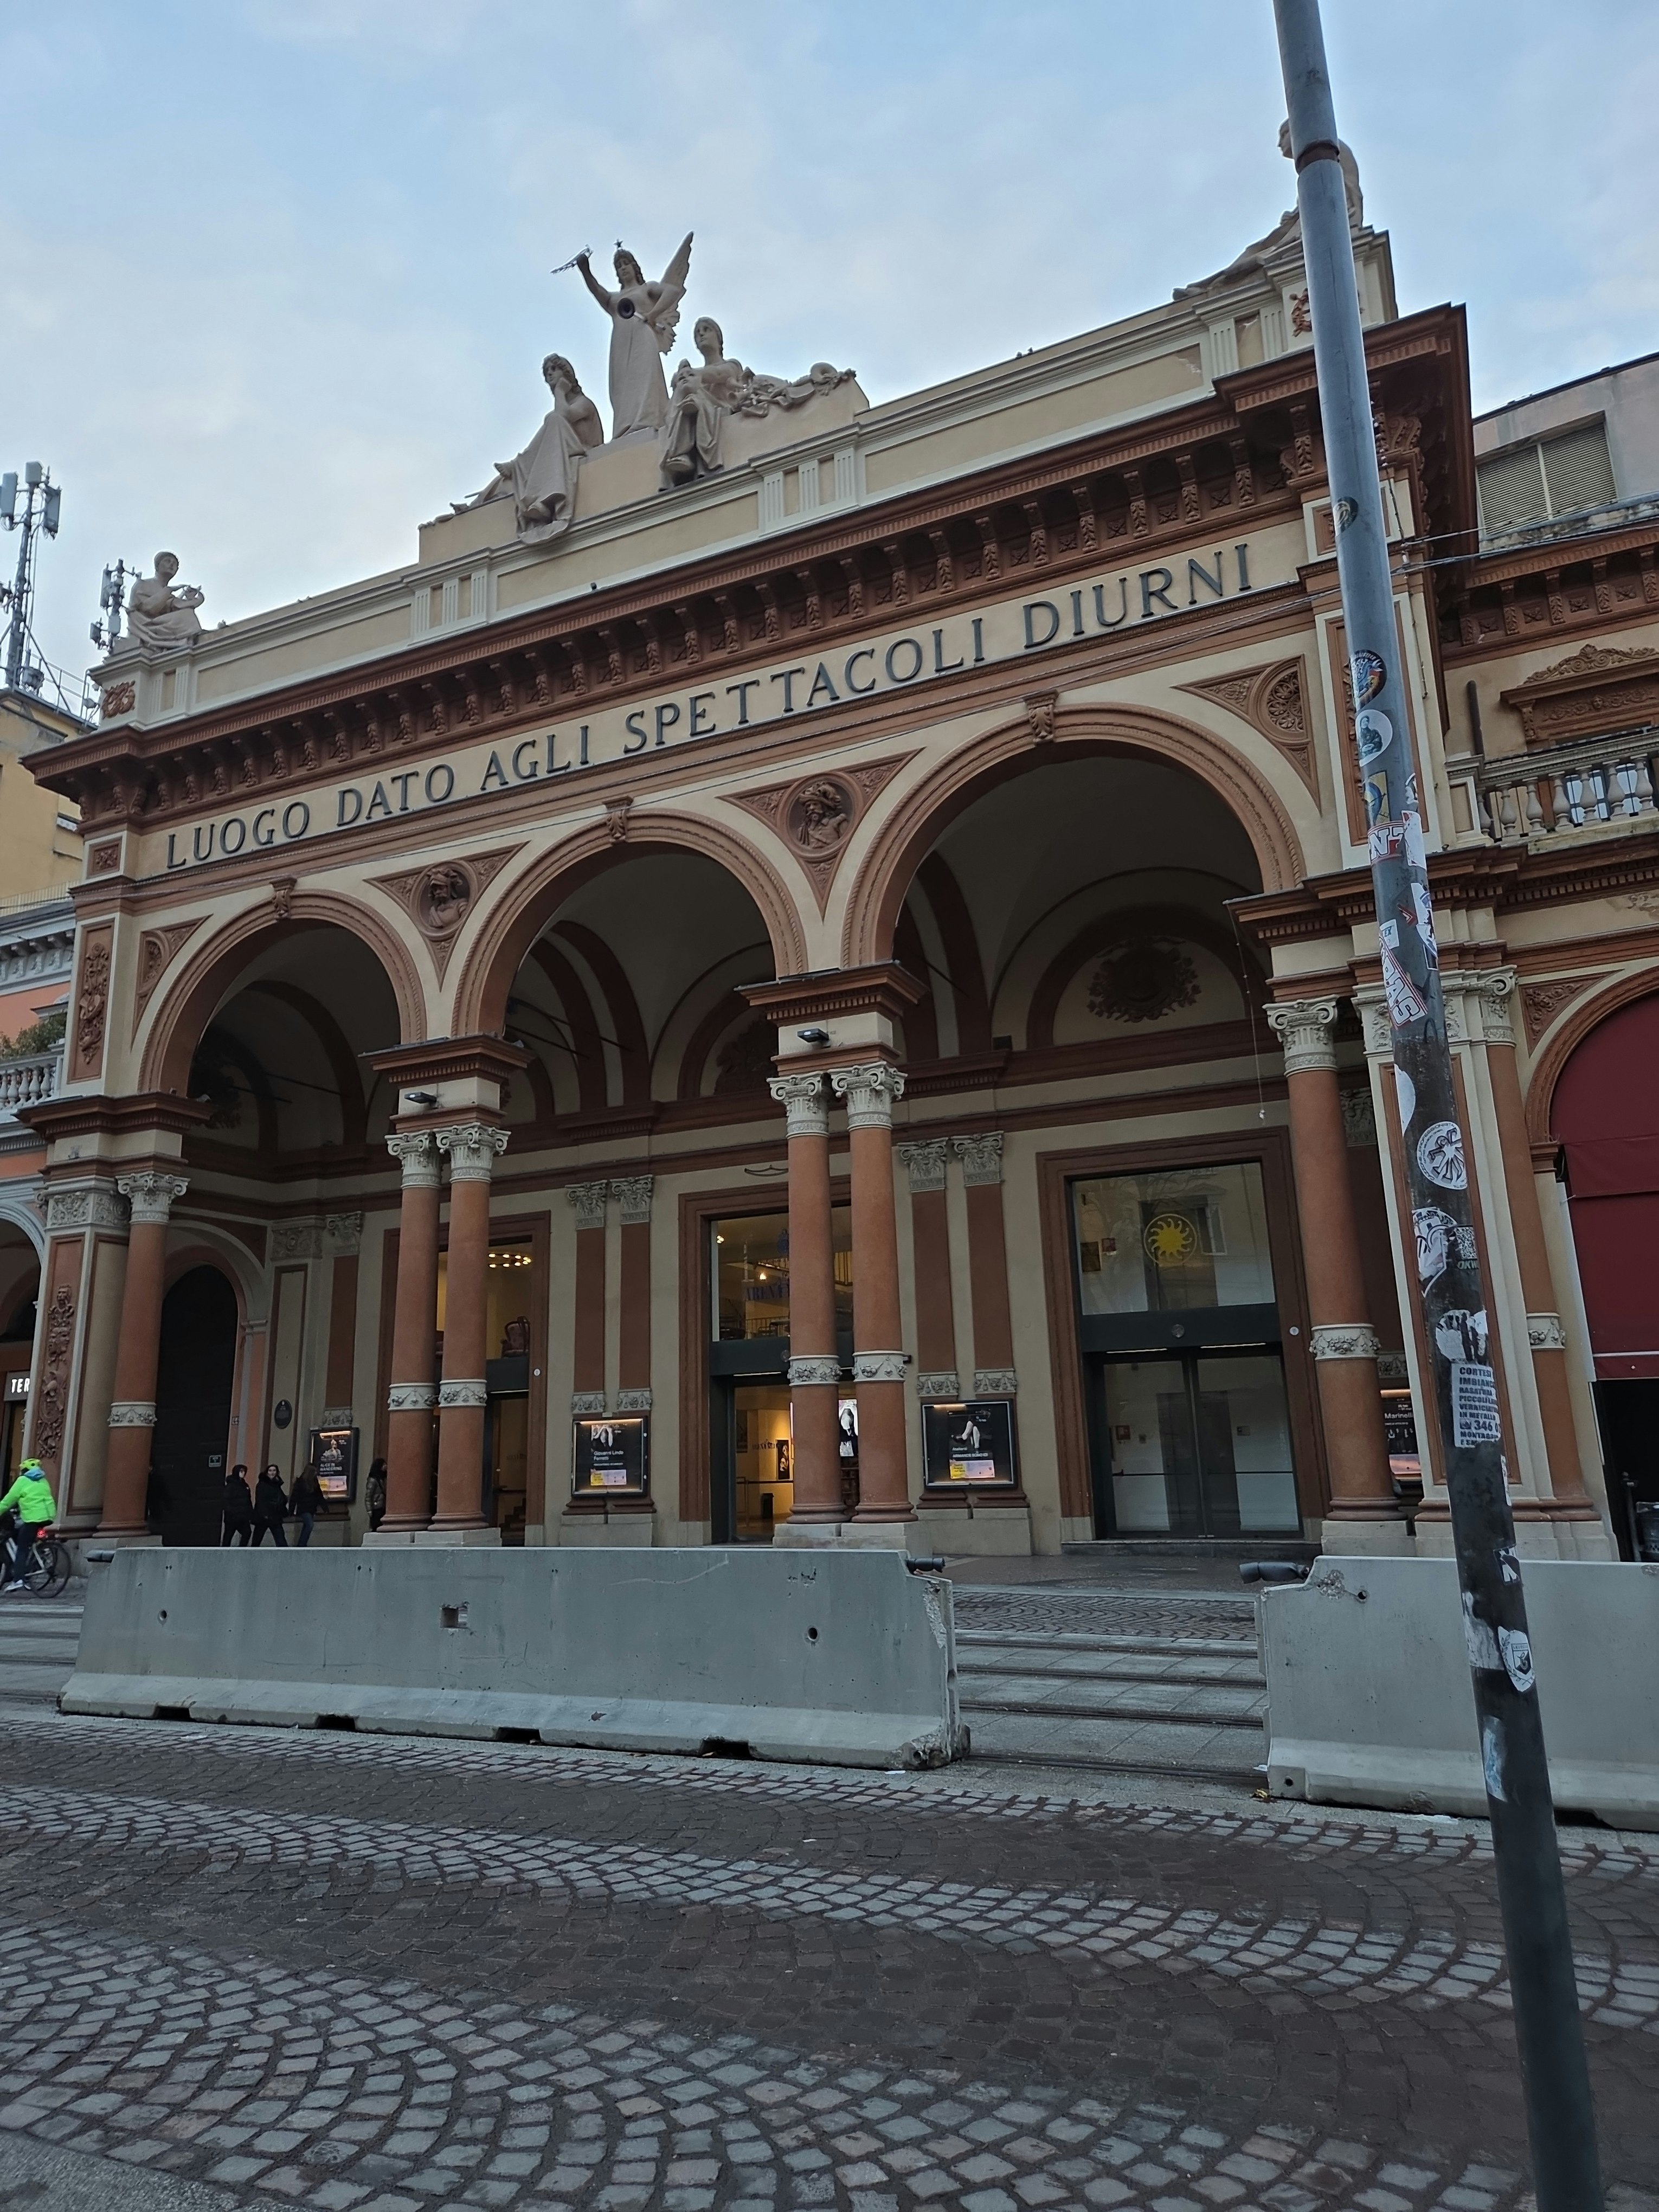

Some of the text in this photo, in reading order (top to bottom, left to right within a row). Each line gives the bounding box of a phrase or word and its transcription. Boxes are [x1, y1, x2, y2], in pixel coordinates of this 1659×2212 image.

[166, 543, 1251, 868] LUOGO DATO AGLI SPETTACOLI DIURNI
[1474, 1419, 1493, 1432] 346
